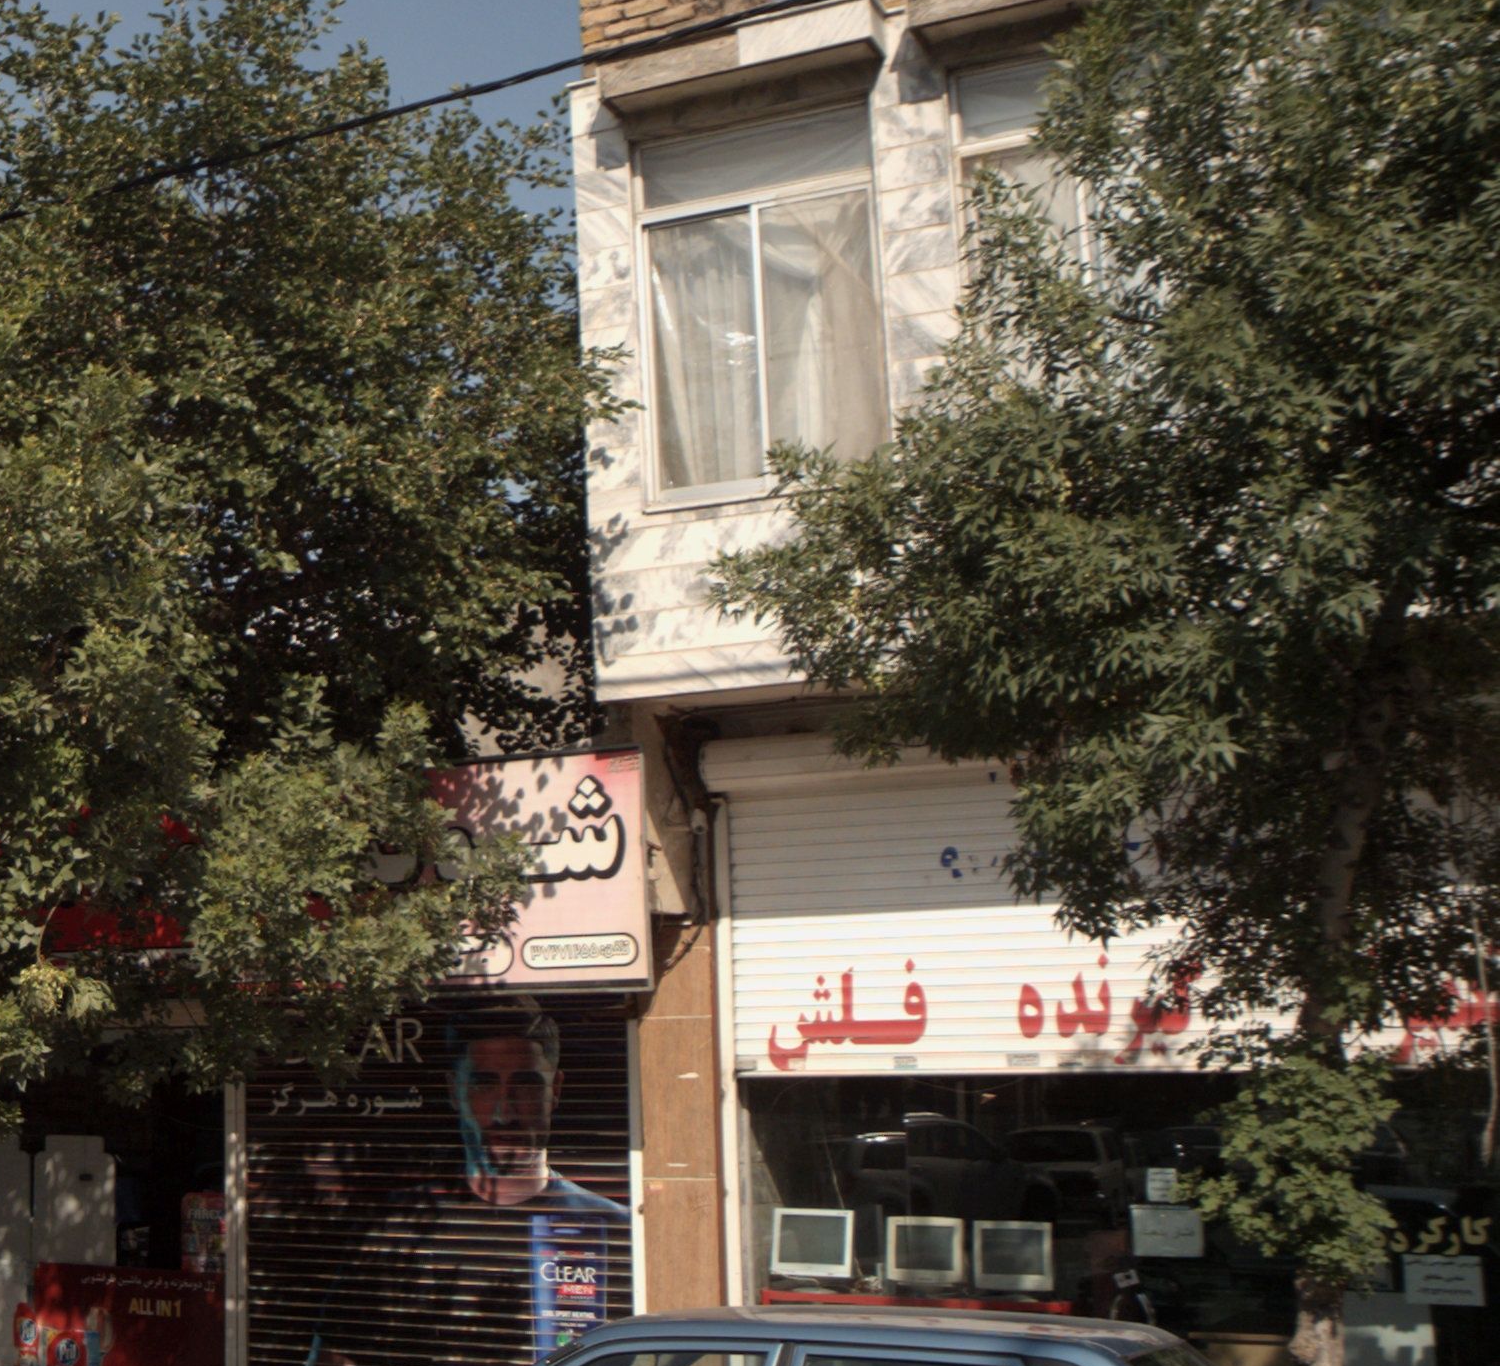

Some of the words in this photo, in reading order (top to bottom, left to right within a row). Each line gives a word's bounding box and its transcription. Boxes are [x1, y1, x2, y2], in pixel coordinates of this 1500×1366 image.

[768, 957, 928, 1071] فلش
[268, 1082, 339, 1117] هرگز
[346, 1086, 424, 1117] شوره
[540, 1262, 596, 1283] CLEAR
[128, 1296, 154, 1316] ALL
[156, 1298, 172, 1317] IN
